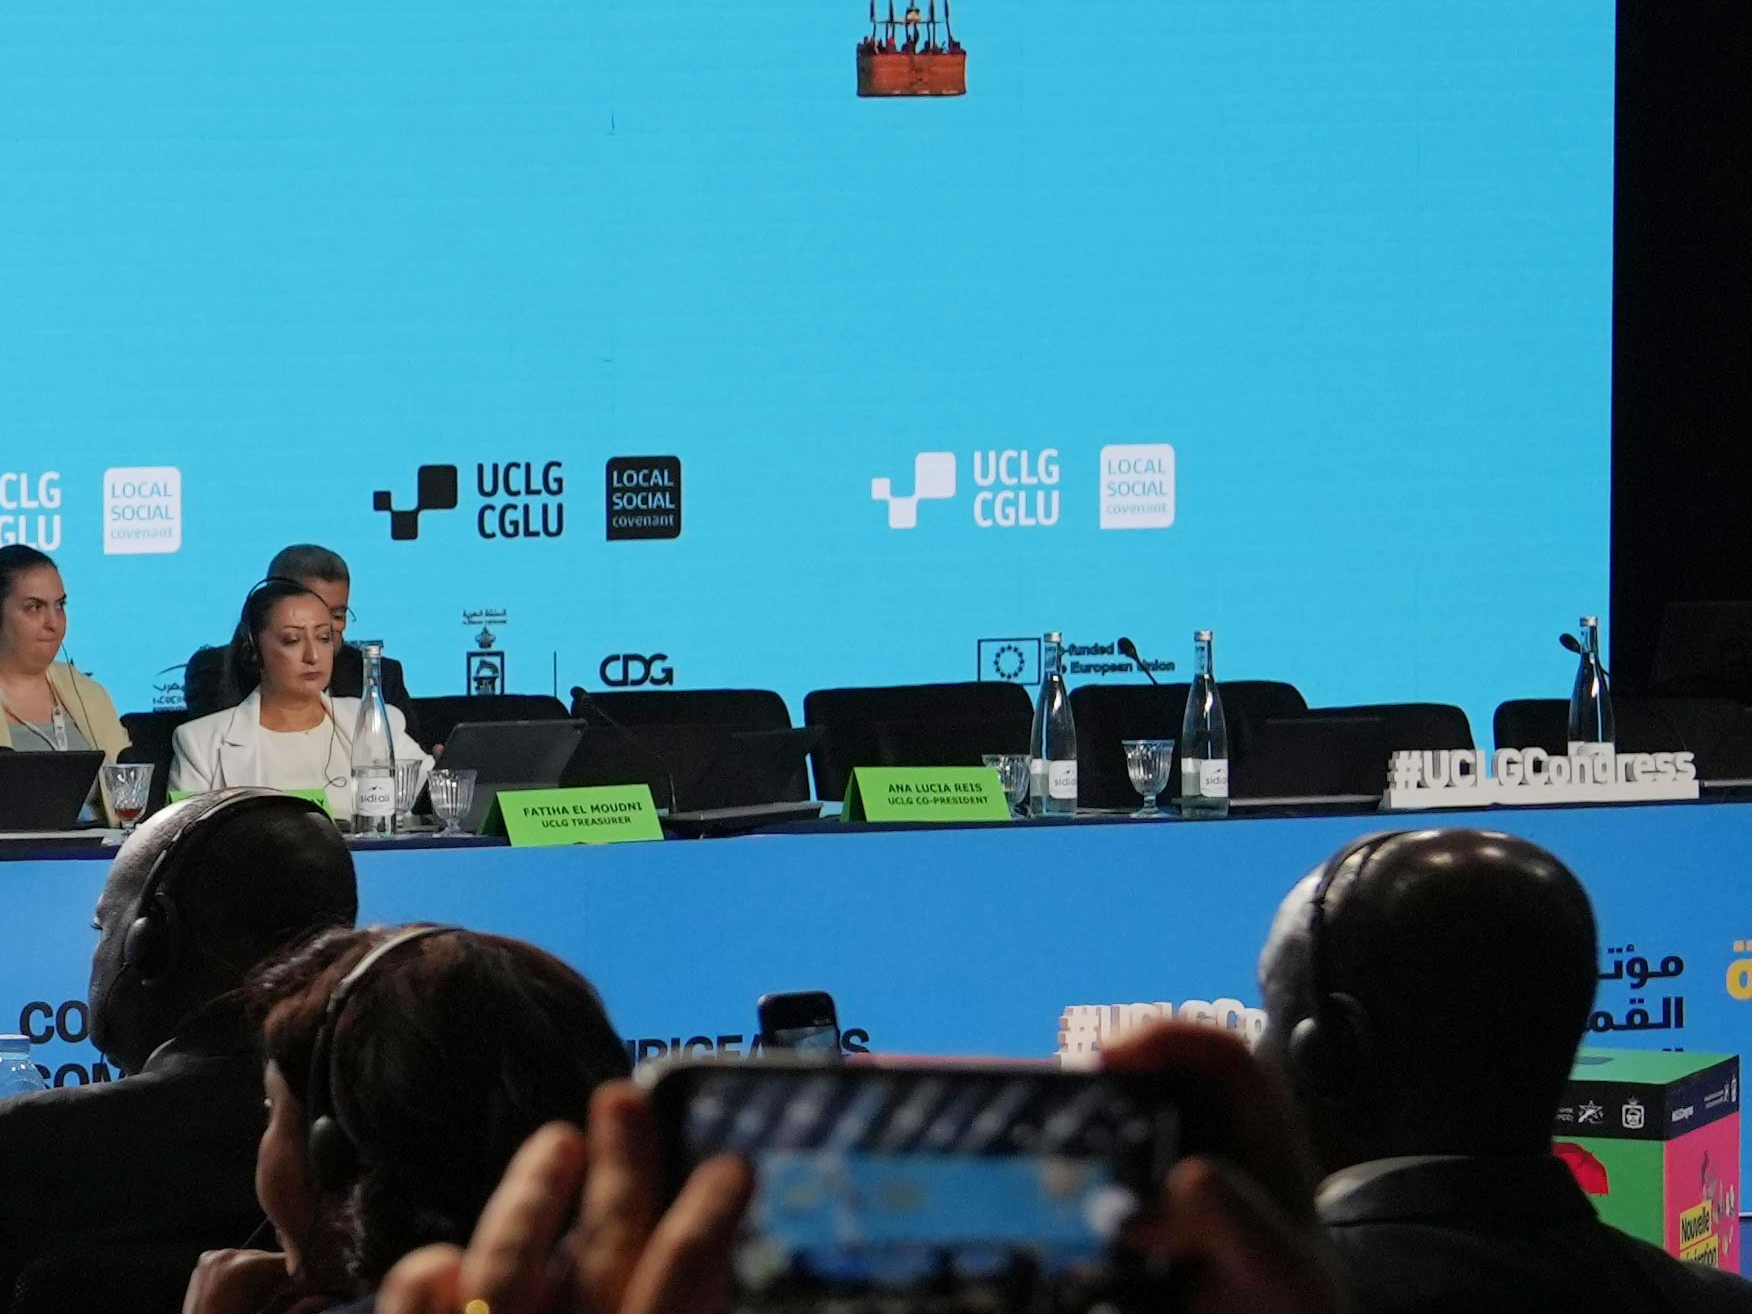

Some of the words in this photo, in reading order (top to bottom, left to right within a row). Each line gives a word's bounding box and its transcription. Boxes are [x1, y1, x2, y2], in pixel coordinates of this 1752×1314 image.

[973, 448, 1060, 487] UCLG
[1107, 458, 1166, 475] LOCAL
[476, 460, 563, 498] UCLG
[612, 469, 674, 488] LOCAL
[111, 481, 173, 499] LOCAL
[1106, 480, 1168, 498] SOCIAL
[612, 492, 675, 510] SOCIAL
[973, 489, 1060, 528] CGLU
[110, 504, 174, 521] SOCIAL
[477, 503, 564, 540] CGLU
[612, 513, 675, 528] covenant
[110, 526, 174, 540] covenant
[599, 653, 674, 687] CDG
[1070, 661, 1133, 675] European
[1387, 747, 1697, 791] #UCLGCongress
[888, 783, 912, 794] ANA
[914, 783, 951, 793] LUCIA
[954, 783, 983, 793] REIS
[523, 805, 568, 817] FATIHA
[573, 804, 587, 815] EL
[590, 801, 643, 814] MOUDNI
[888, 797, 914, 806] UCLG
[916, 796, 989, 805] CO-PRESIDENT
[541, 818, 569, 828] UCLG
[571, 816, 632, 827] TREASURER
